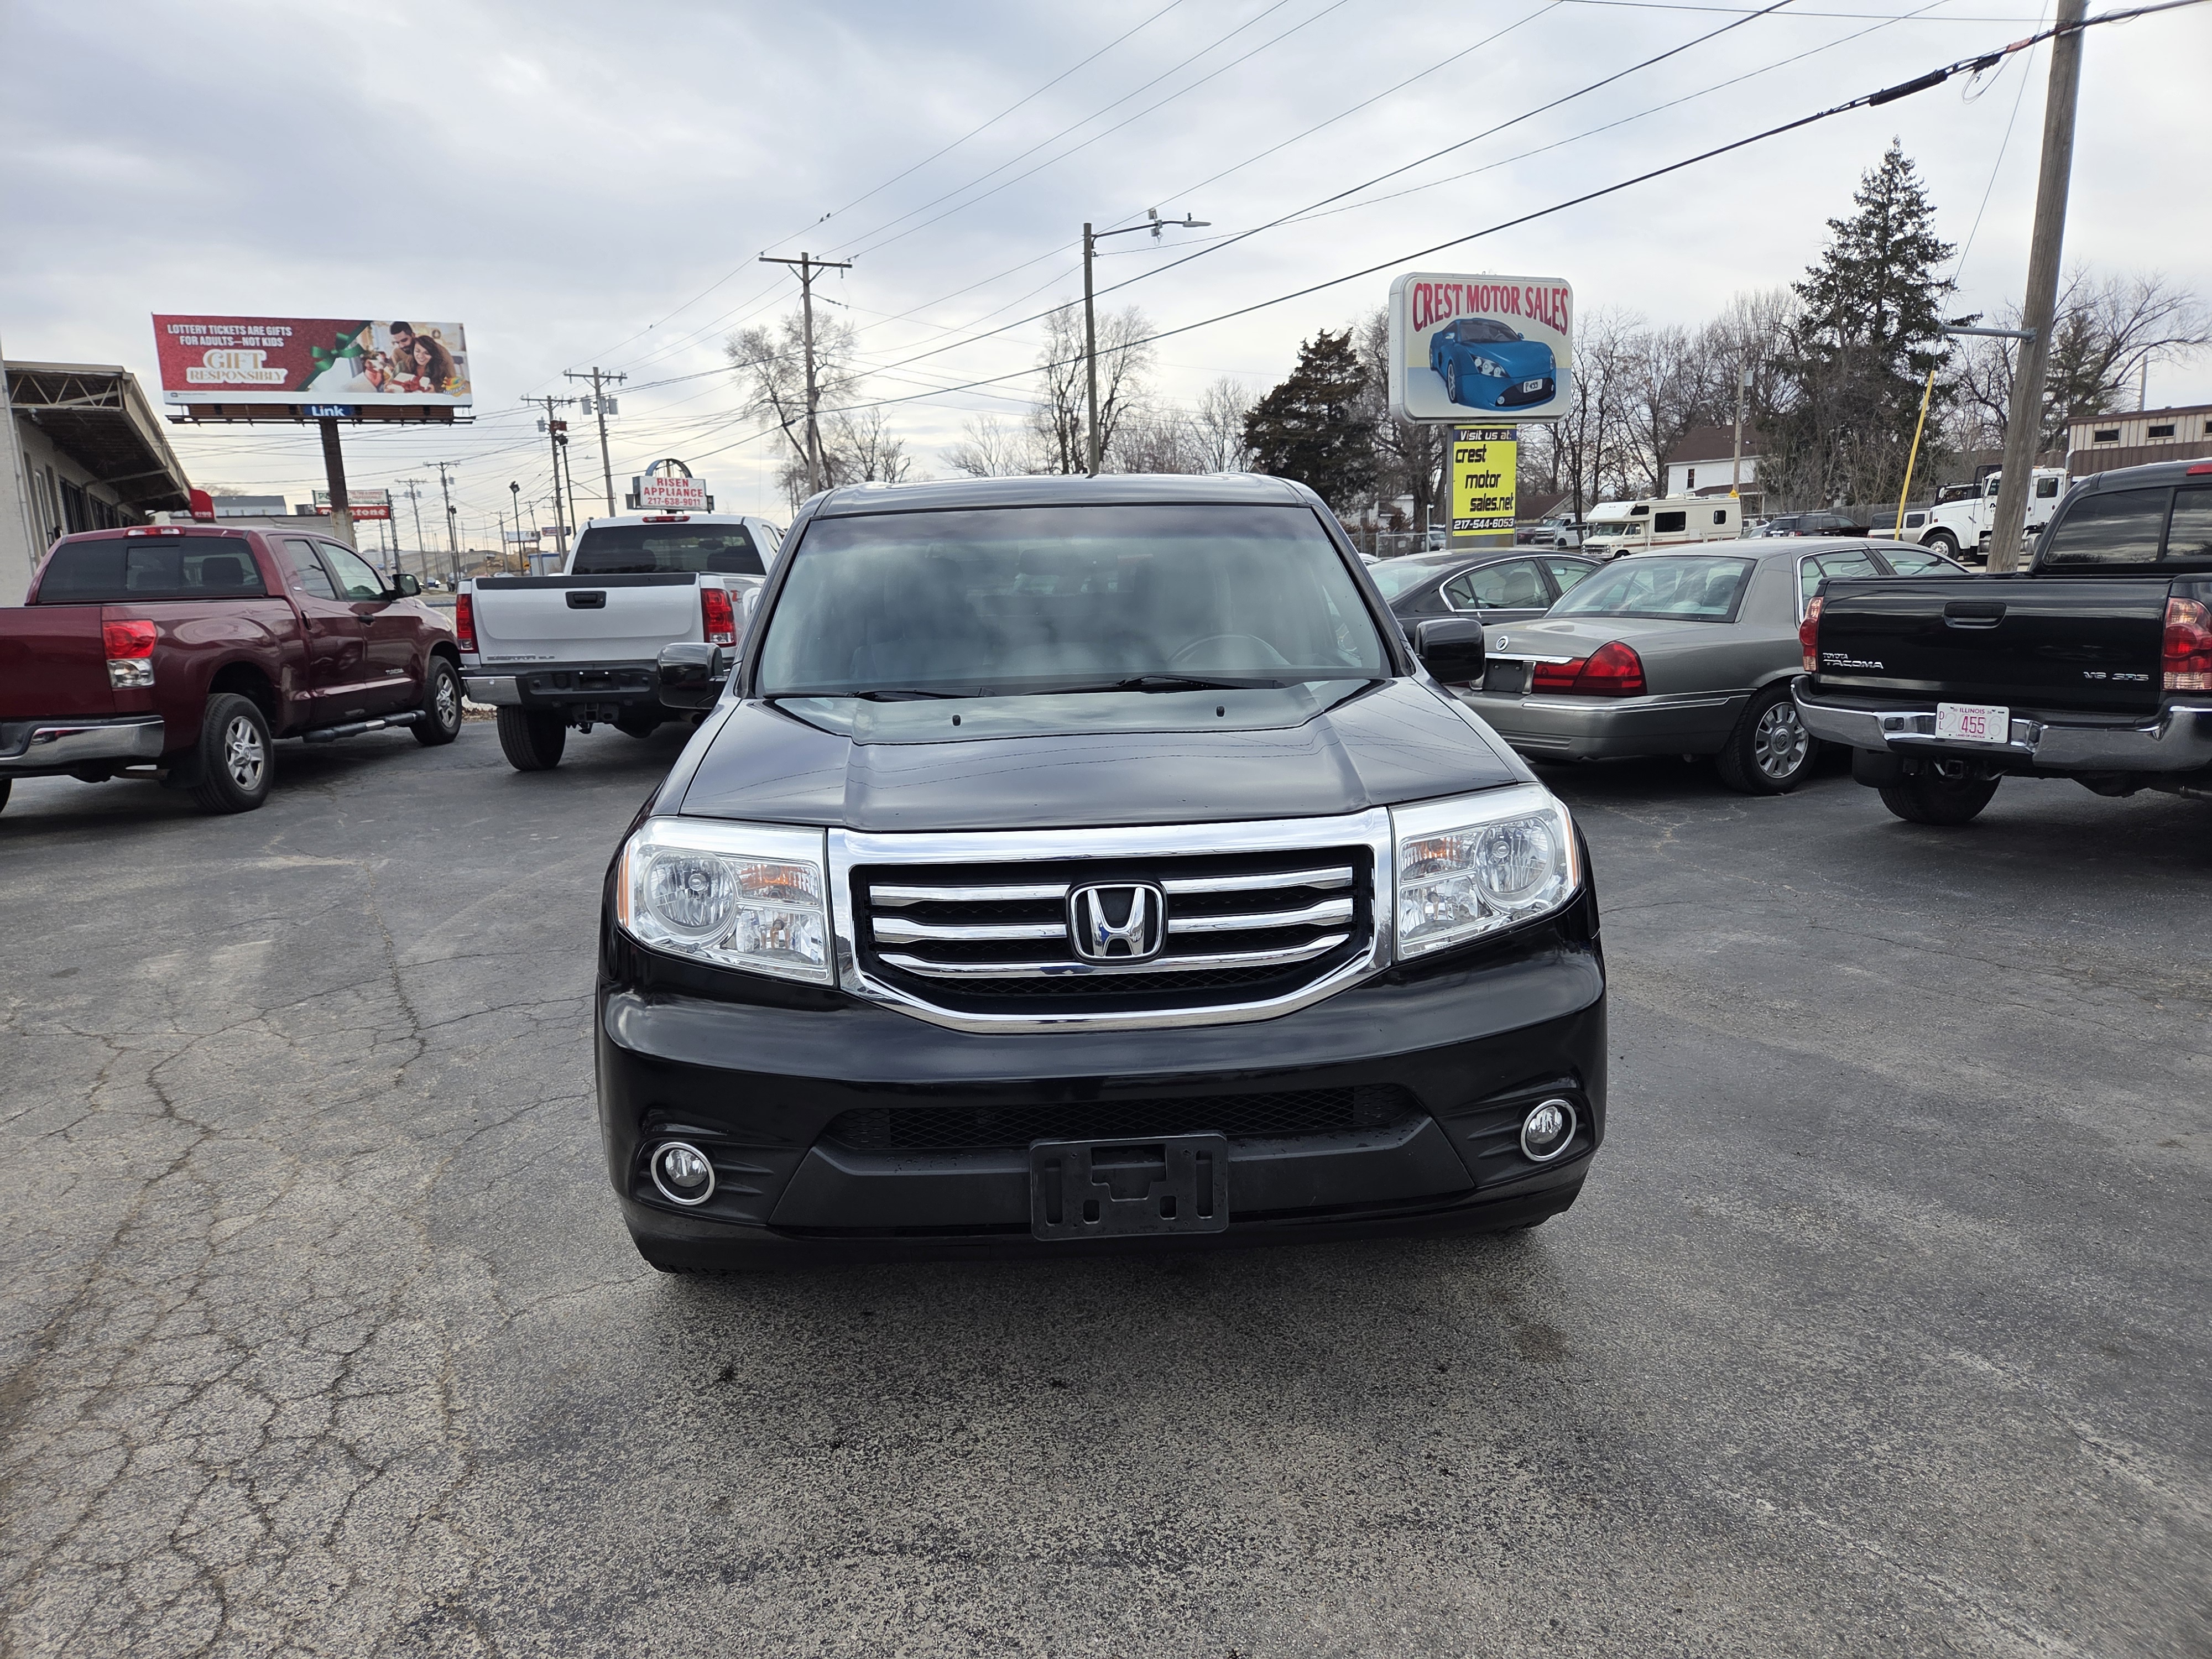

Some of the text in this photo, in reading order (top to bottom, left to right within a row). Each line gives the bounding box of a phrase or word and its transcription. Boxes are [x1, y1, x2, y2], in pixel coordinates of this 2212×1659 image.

[1412, 283, 1568, 336] CREST MOTOR SALES
[167, 324, 293, 336] LOTTERY TICKETS ARE GIFTS
[180, 336, 199, 346] FOR
[262, 337, 284, 347] KIDS
[207, 352, 264, 369] GIFT
[190, 371, 285, 381] RESPONSIBLY
[311, 405, 346, 416] Link
[1460, 430, 1511, 441] Visit us at:
[1455, 444, 1486, 463] crest
[656, 478, 689, 487] RISEN
[1465, 469, 1501, 489] motor
[644, 487, 703, 497] APPLIANCE
[648, 497, 701, 506] 217-638-9011
[1470, 492, 1514, 512] sales.net
[1454, 518, 1514, 530] 217-544-6053
[1823, 659, 1884, 669] TACOMA
[1961, 716, 1986, 734] 455
